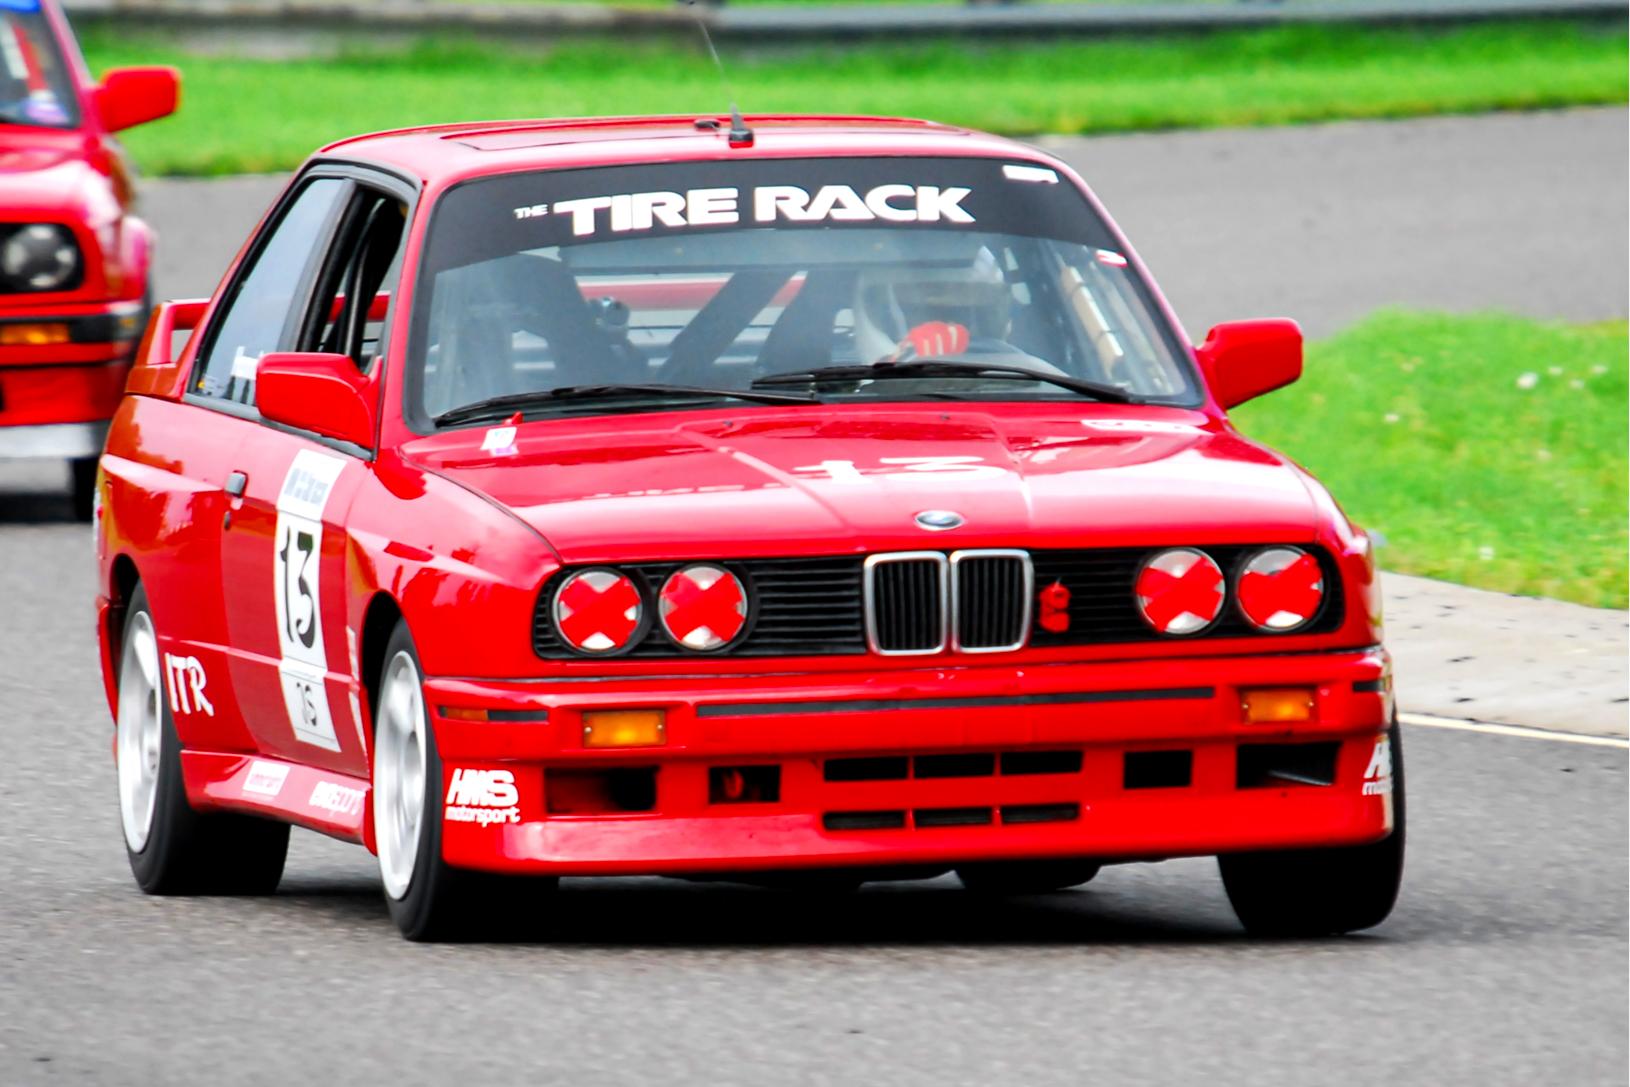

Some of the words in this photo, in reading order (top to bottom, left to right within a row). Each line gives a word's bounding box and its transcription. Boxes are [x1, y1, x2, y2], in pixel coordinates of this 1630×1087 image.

[514, 204, 549, 219] THE
[553, 187, 739, 236] TIRE
[754, 184, 976, 223] RACK
[793, 455, 1007, 484] 13
[280, 525, 315, 649] 13
[165, 652, 214, 716] ITR
[446, 768, 519, 807] HMS
